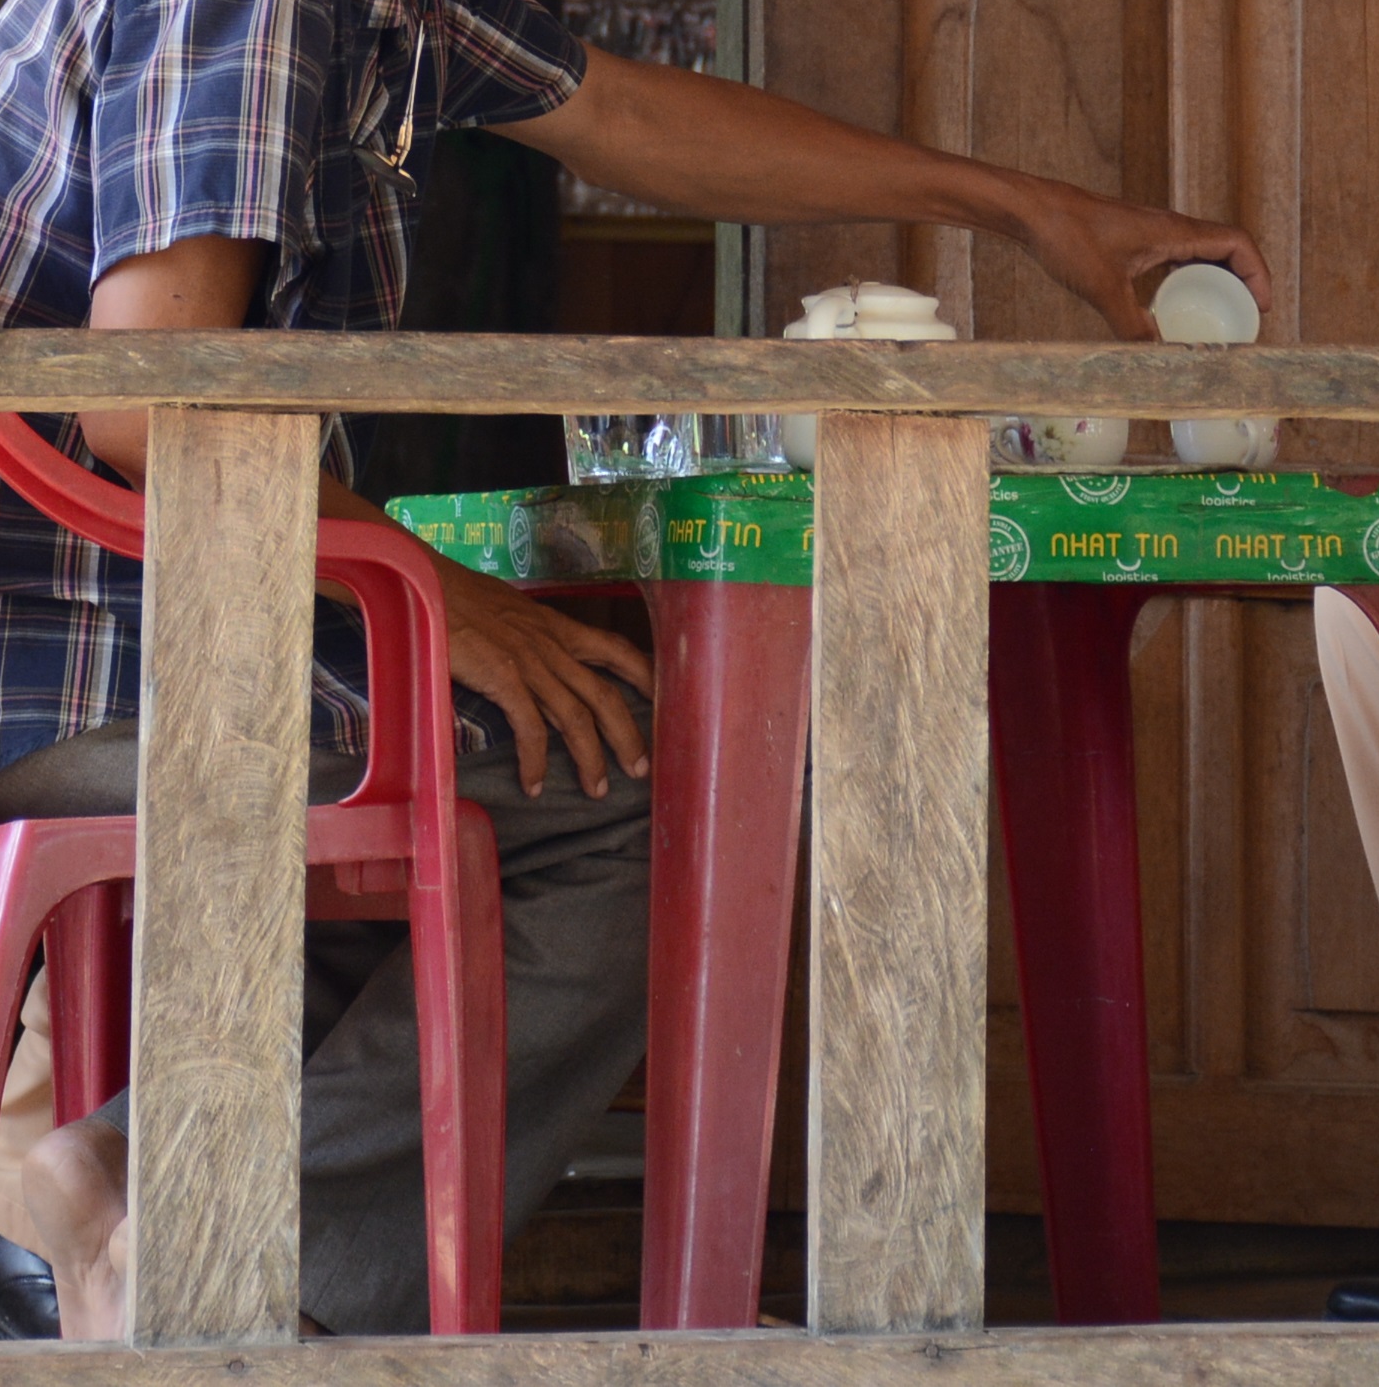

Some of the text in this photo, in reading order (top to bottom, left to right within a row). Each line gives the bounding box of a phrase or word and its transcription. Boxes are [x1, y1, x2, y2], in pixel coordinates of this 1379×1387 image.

[667, 519, 762, 548] NHAT TIN
[1051, 532, 1178, 558] NHAT TIN
[1215, 533, 1343, 559] NHAT TIN
[688, 558, 736, 572] logistics
